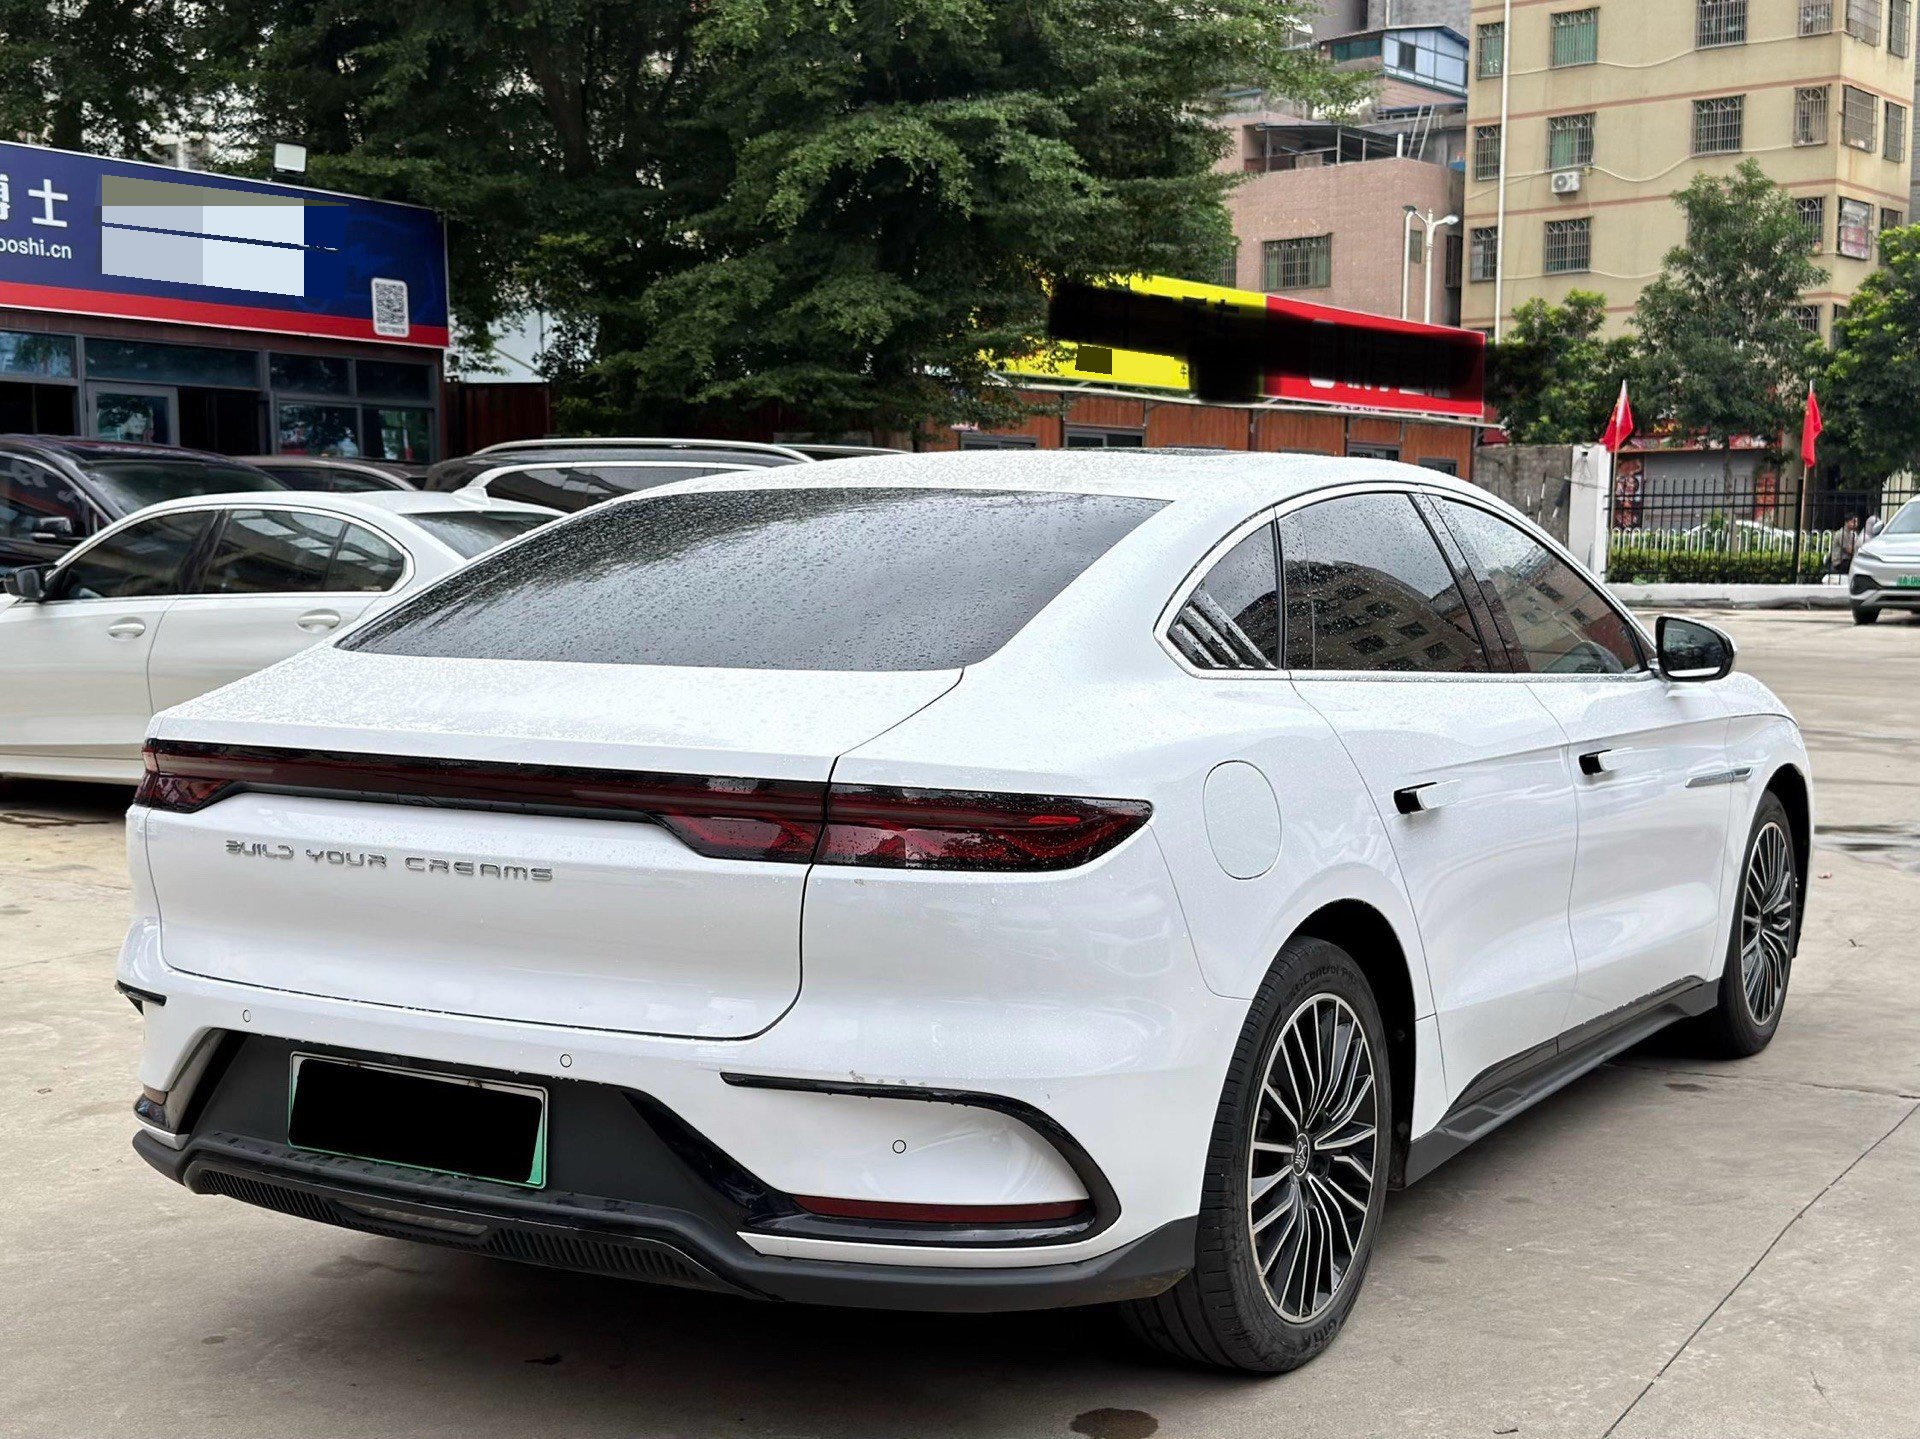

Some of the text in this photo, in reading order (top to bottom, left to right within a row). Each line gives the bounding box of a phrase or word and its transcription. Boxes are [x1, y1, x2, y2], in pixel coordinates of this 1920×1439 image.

[0, 173, 68, 228] 士
[226, 840, 294, 860] BUILD
[306, 849, 387, 868] YOUR
